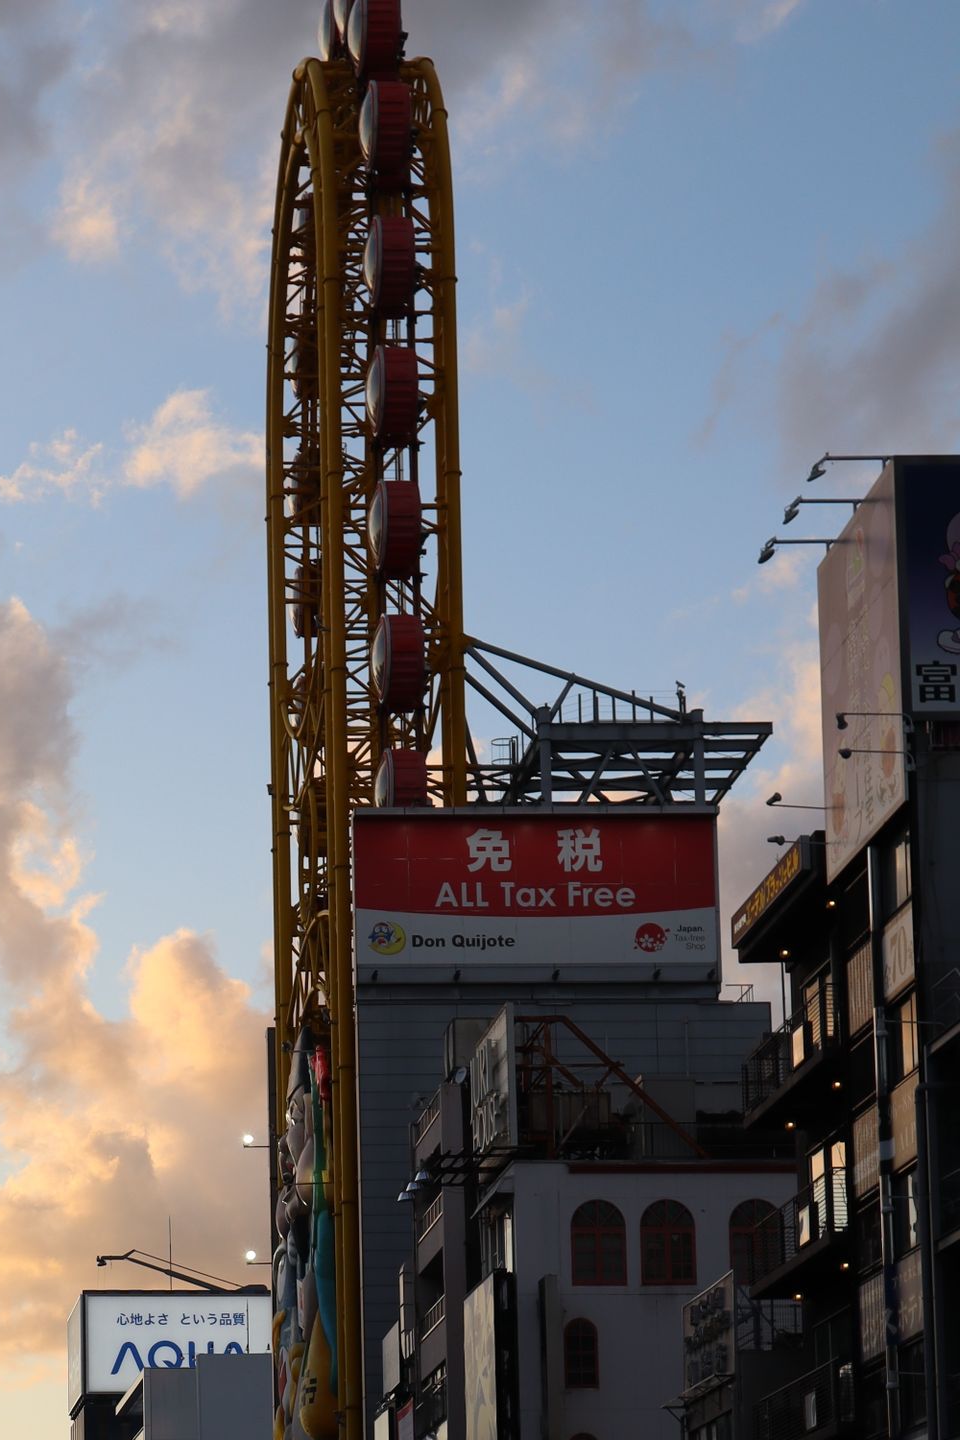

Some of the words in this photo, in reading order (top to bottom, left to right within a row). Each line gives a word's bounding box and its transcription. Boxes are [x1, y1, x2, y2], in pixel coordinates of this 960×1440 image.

[916, 660, 957, 703] 富
[466, 828, 603, 873] 免税
[435, 882, 489, 908] ALL
[500, 882, 556, 908] Tax
[568, 882, 636, 908] Free
[411, 934, 446, 948] Don
[451, 933, 515, 951] Quijote
[685, 943, 706, 952] Shop
[116, 1312, 169, 1326] 心地よさ
[180, 1312, 246, 1326] という品質
